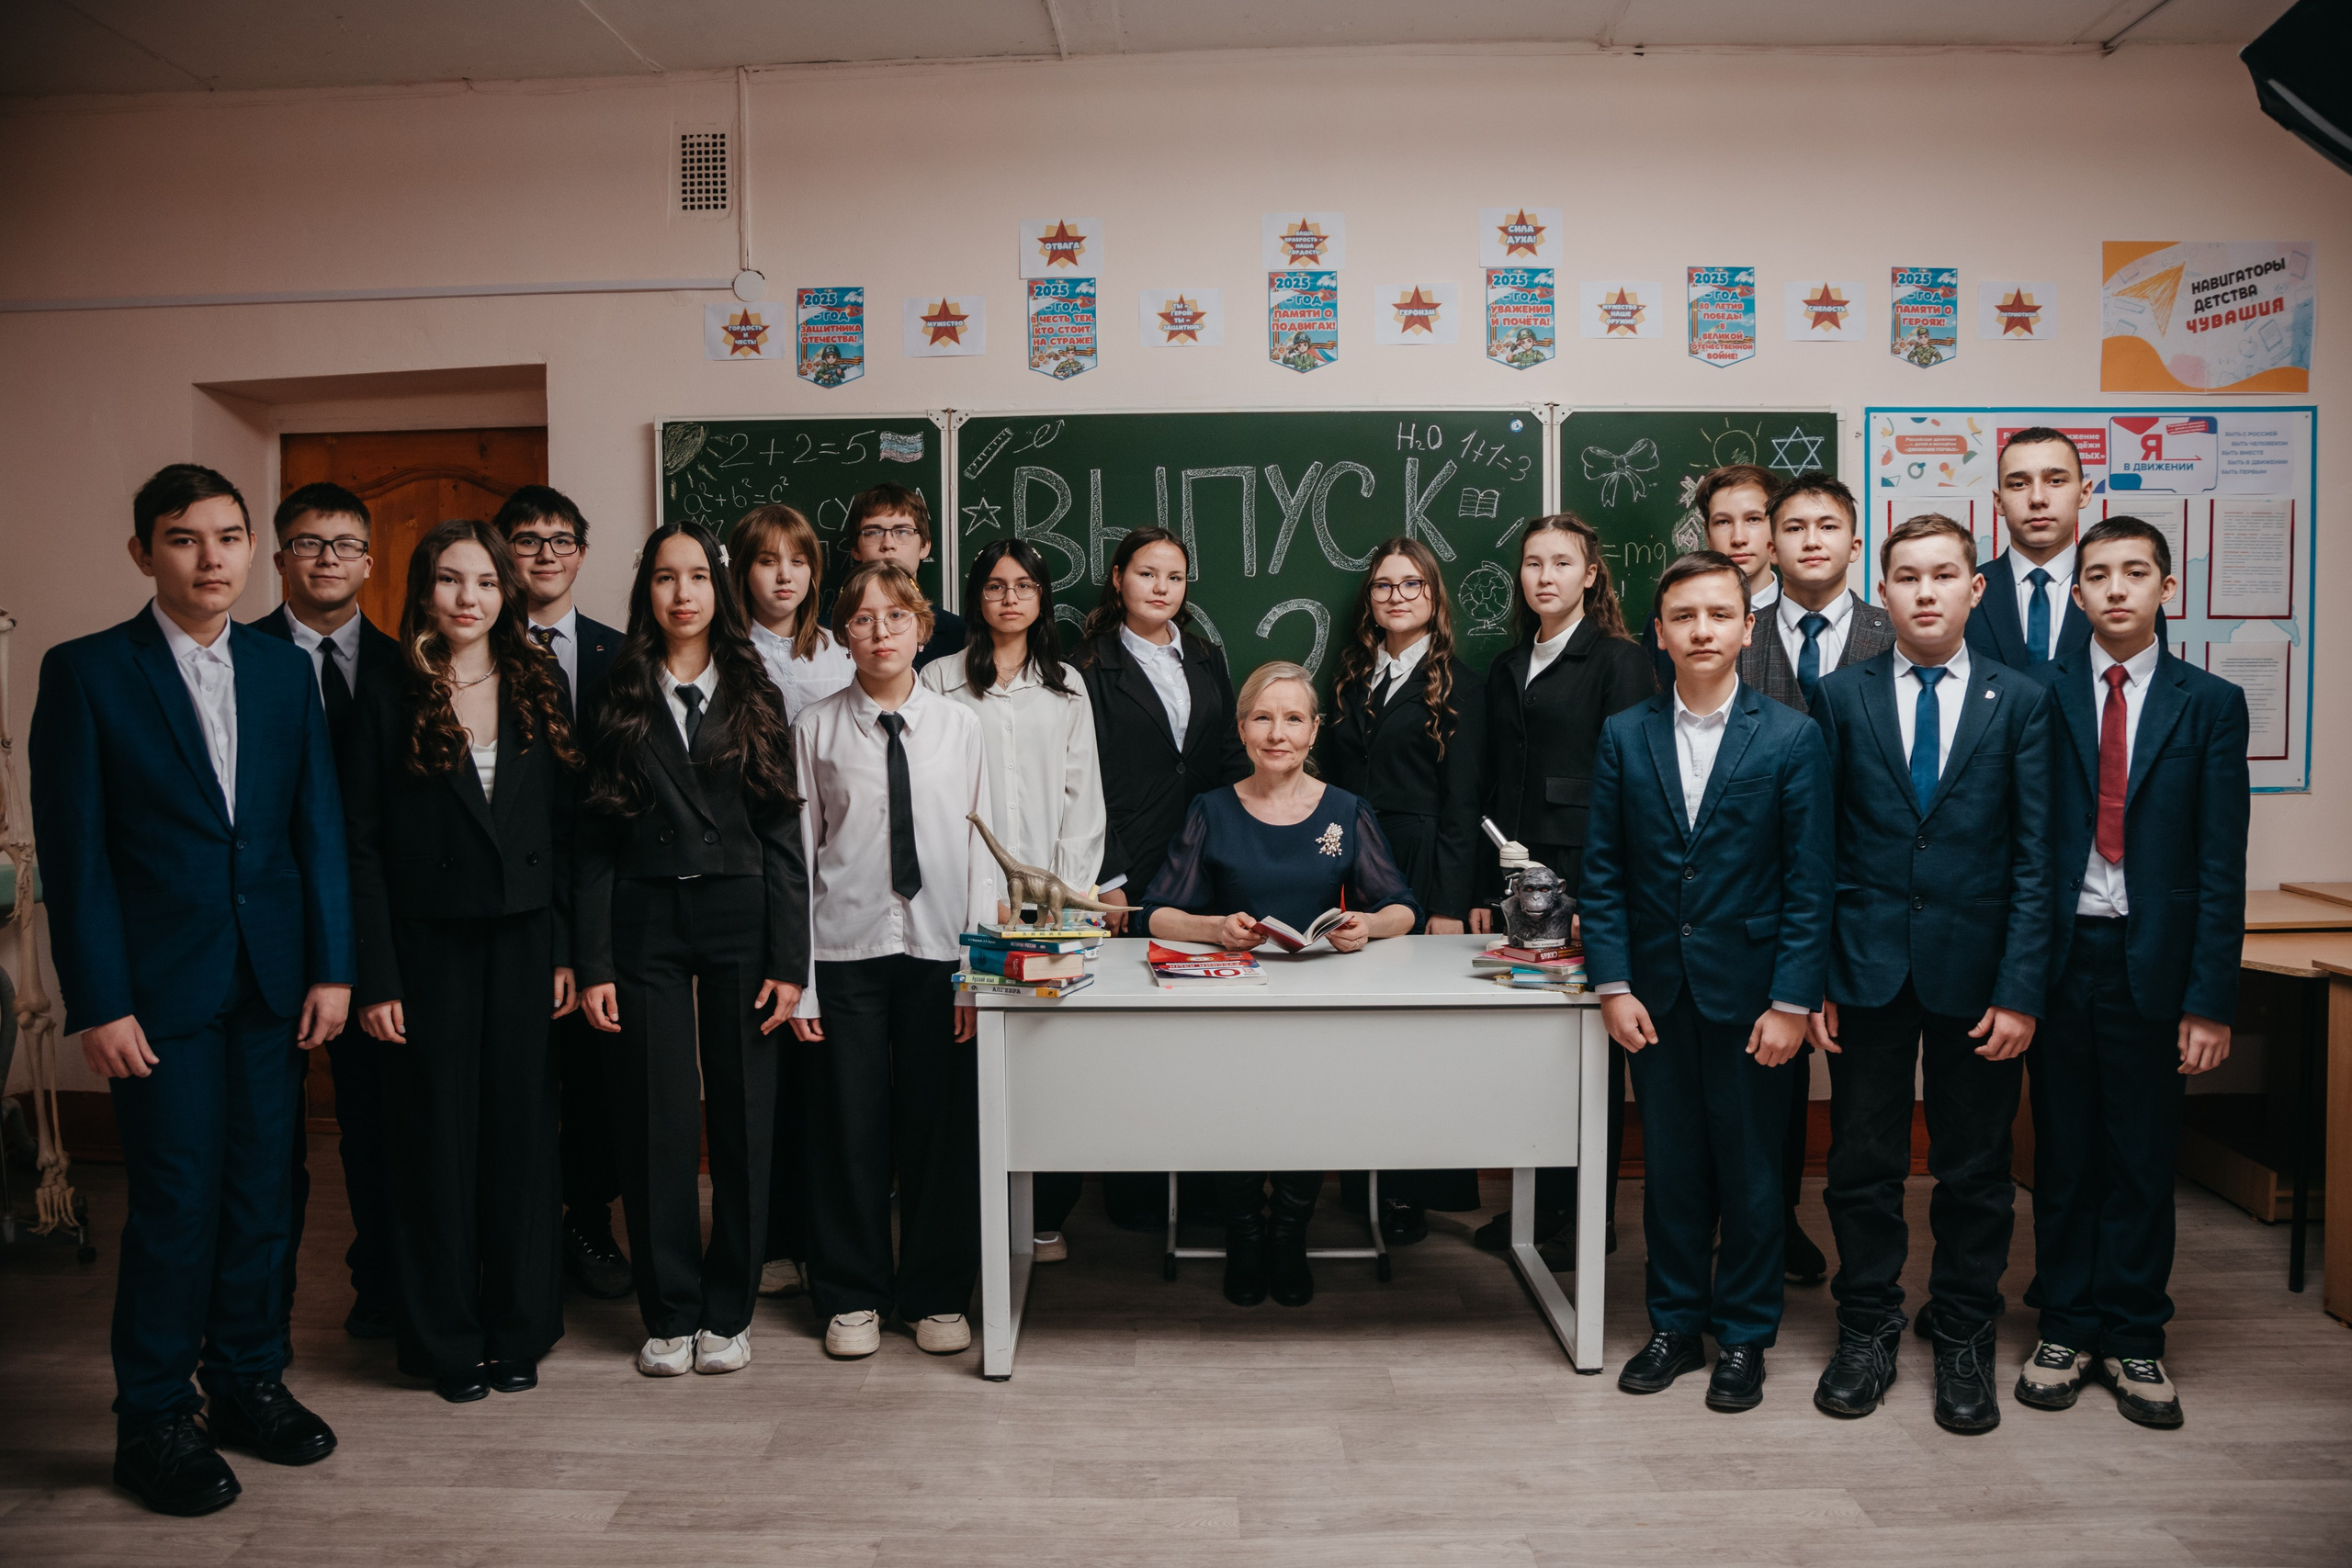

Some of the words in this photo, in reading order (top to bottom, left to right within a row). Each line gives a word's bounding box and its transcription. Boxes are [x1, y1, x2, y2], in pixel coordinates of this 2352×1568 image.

[1506, 236, 1537, 244] ДУХА!
[1044, 242, 1080, 251] ОТВАГА
[1493, 275, 1527, 286] 2025
[1694, 273, 1727, 284] 2025
[1898, 273, 1930, 284] 2025
[2191, 257, 2286, 295] НАВИГАТОРЫ
[1275, 277, 1309, 289] 2025
[1035, 285, 1069, 297] 2025
[1715, 290, 1740, 301] ГОД
[804, 294, 837, 306] 2025
[1296, 296, 1321, 305] ГОД
[1514, 292, 1539, 302] ГОД
[1918, 291, 1942, 302] ГОД
[2194, 284, 2257, 314] ДЕТСТВА
[1056, 302, 1080, 313] ГОД
[1490, 305, 1551, 313] УВАЖЕНИЯ
[1808, 305, 1847, 313] СМЕЛОСТЬ
[1895, 305, 1941, 314] ПАМЯТИ
[1944, 305, 1953, 314] О
[824, 311, 849, 321] ГОД
[1039, 315, 1070, 323] ЧЕСТЬ
[1074, 314, 1095, 323] ТЕХ,
[1274, 310, 1320, 318] ПАМЯТИ
[1324, 309, 1333, 318] О
[2186, 297, 2284, 333] ЧУВАШИЯ
[1503, 315, 1550, 326] ПОЧЁТА!
[1902, 318, 1946, 327] ГЕРОЯХ!
[800, 325, 862, 333] ЗАЩИТНИКА
[1057, 325, 1091, 333] СТОИТ
[1272, 321, 1336, 332] ПОДВИГАХ!
[1033, 338, 1047, 346] НА
[1049, 336, 1093, 345] СТРАЖЕ!
[1702, 332, 1743, 340] ВЕЛИКОЙ
[1707, 352, 1738, 360] ВОЙНЕ!
[2141, 434, 2163, 460] Я
[2123, 463, 2131, 471] В
[2133, 462, 2194, 472] ДВИЖЕНИИ
[1014, 457, 1457, 592] ВЫПУСК
[992, 987, 1022, 995] АЛГЕБРА
